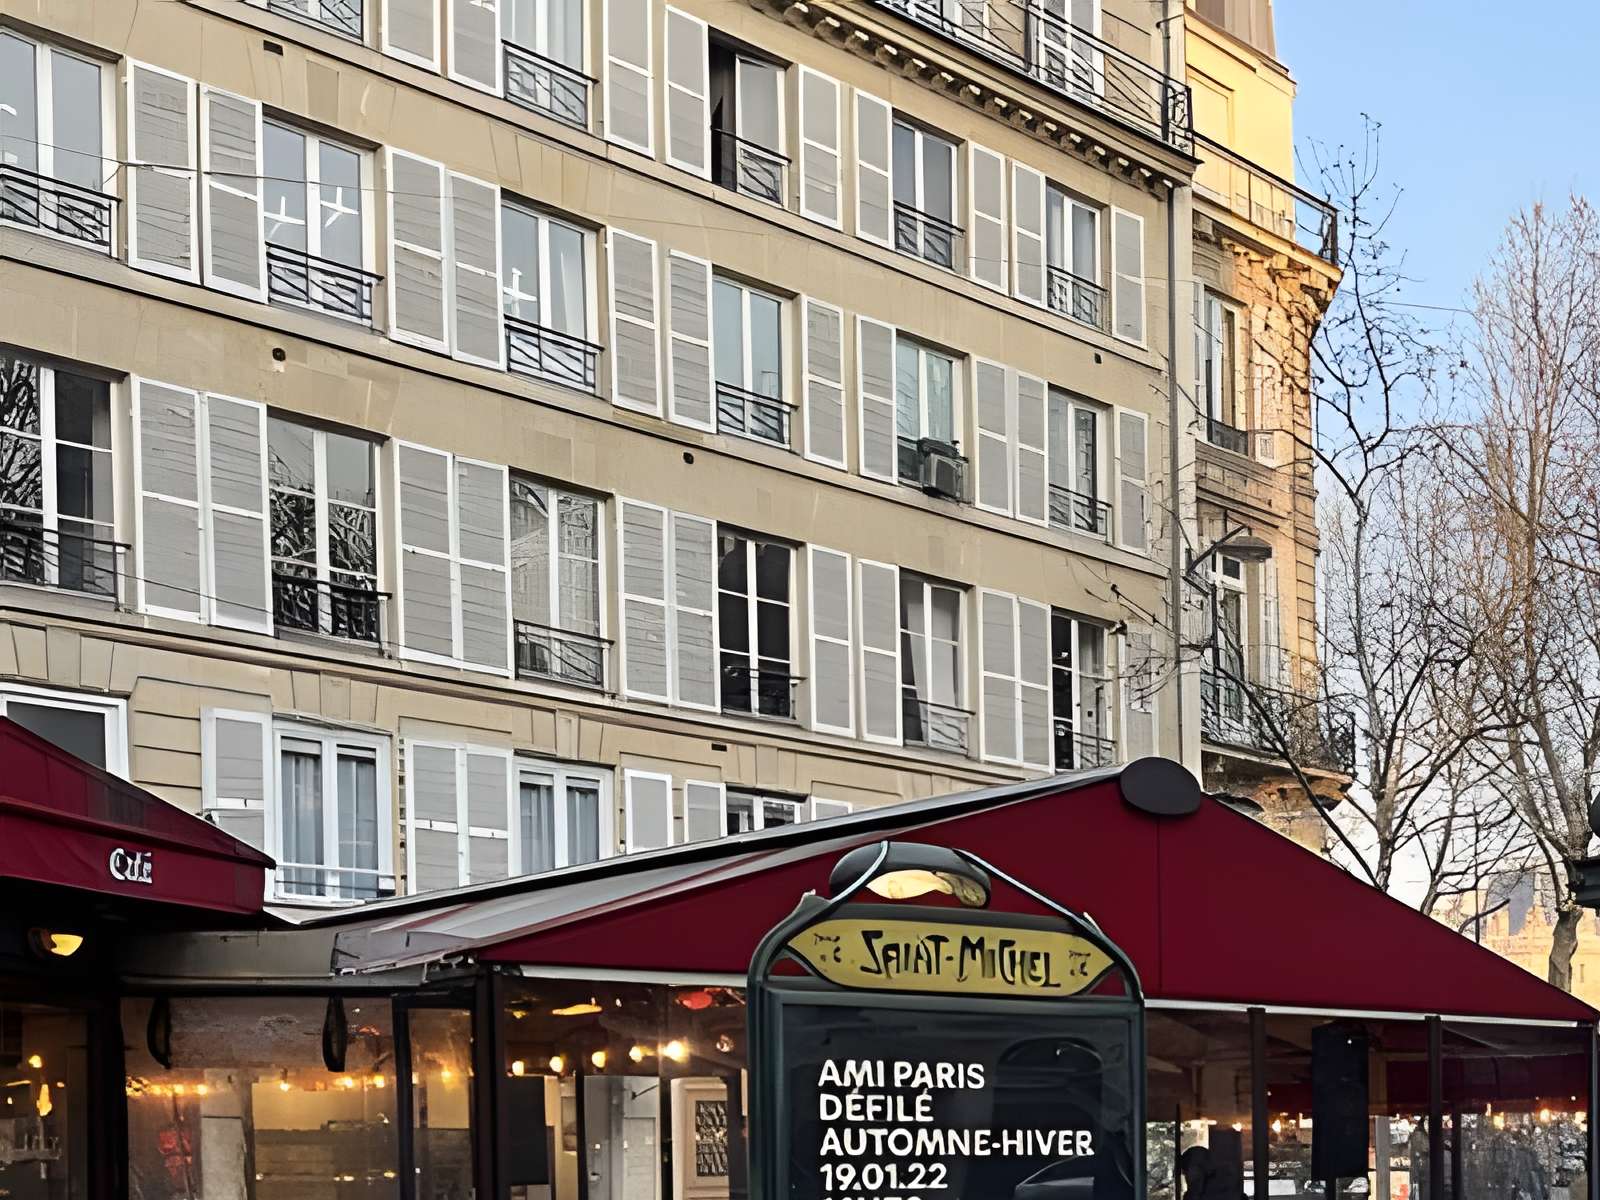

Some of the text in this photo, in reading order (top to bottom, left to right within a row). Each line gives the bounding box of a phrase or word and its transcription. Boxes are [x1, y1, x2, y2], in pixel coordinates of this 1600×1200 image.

[818, 1059, 985, 1089] AMI PARIS
[819, 1087, 934, 1122] DÉFILÉ
[819, 1128, 1095, 1156] AUTOMNE-HIVER
[819, 1162, 948, 1191] 19.01.22
